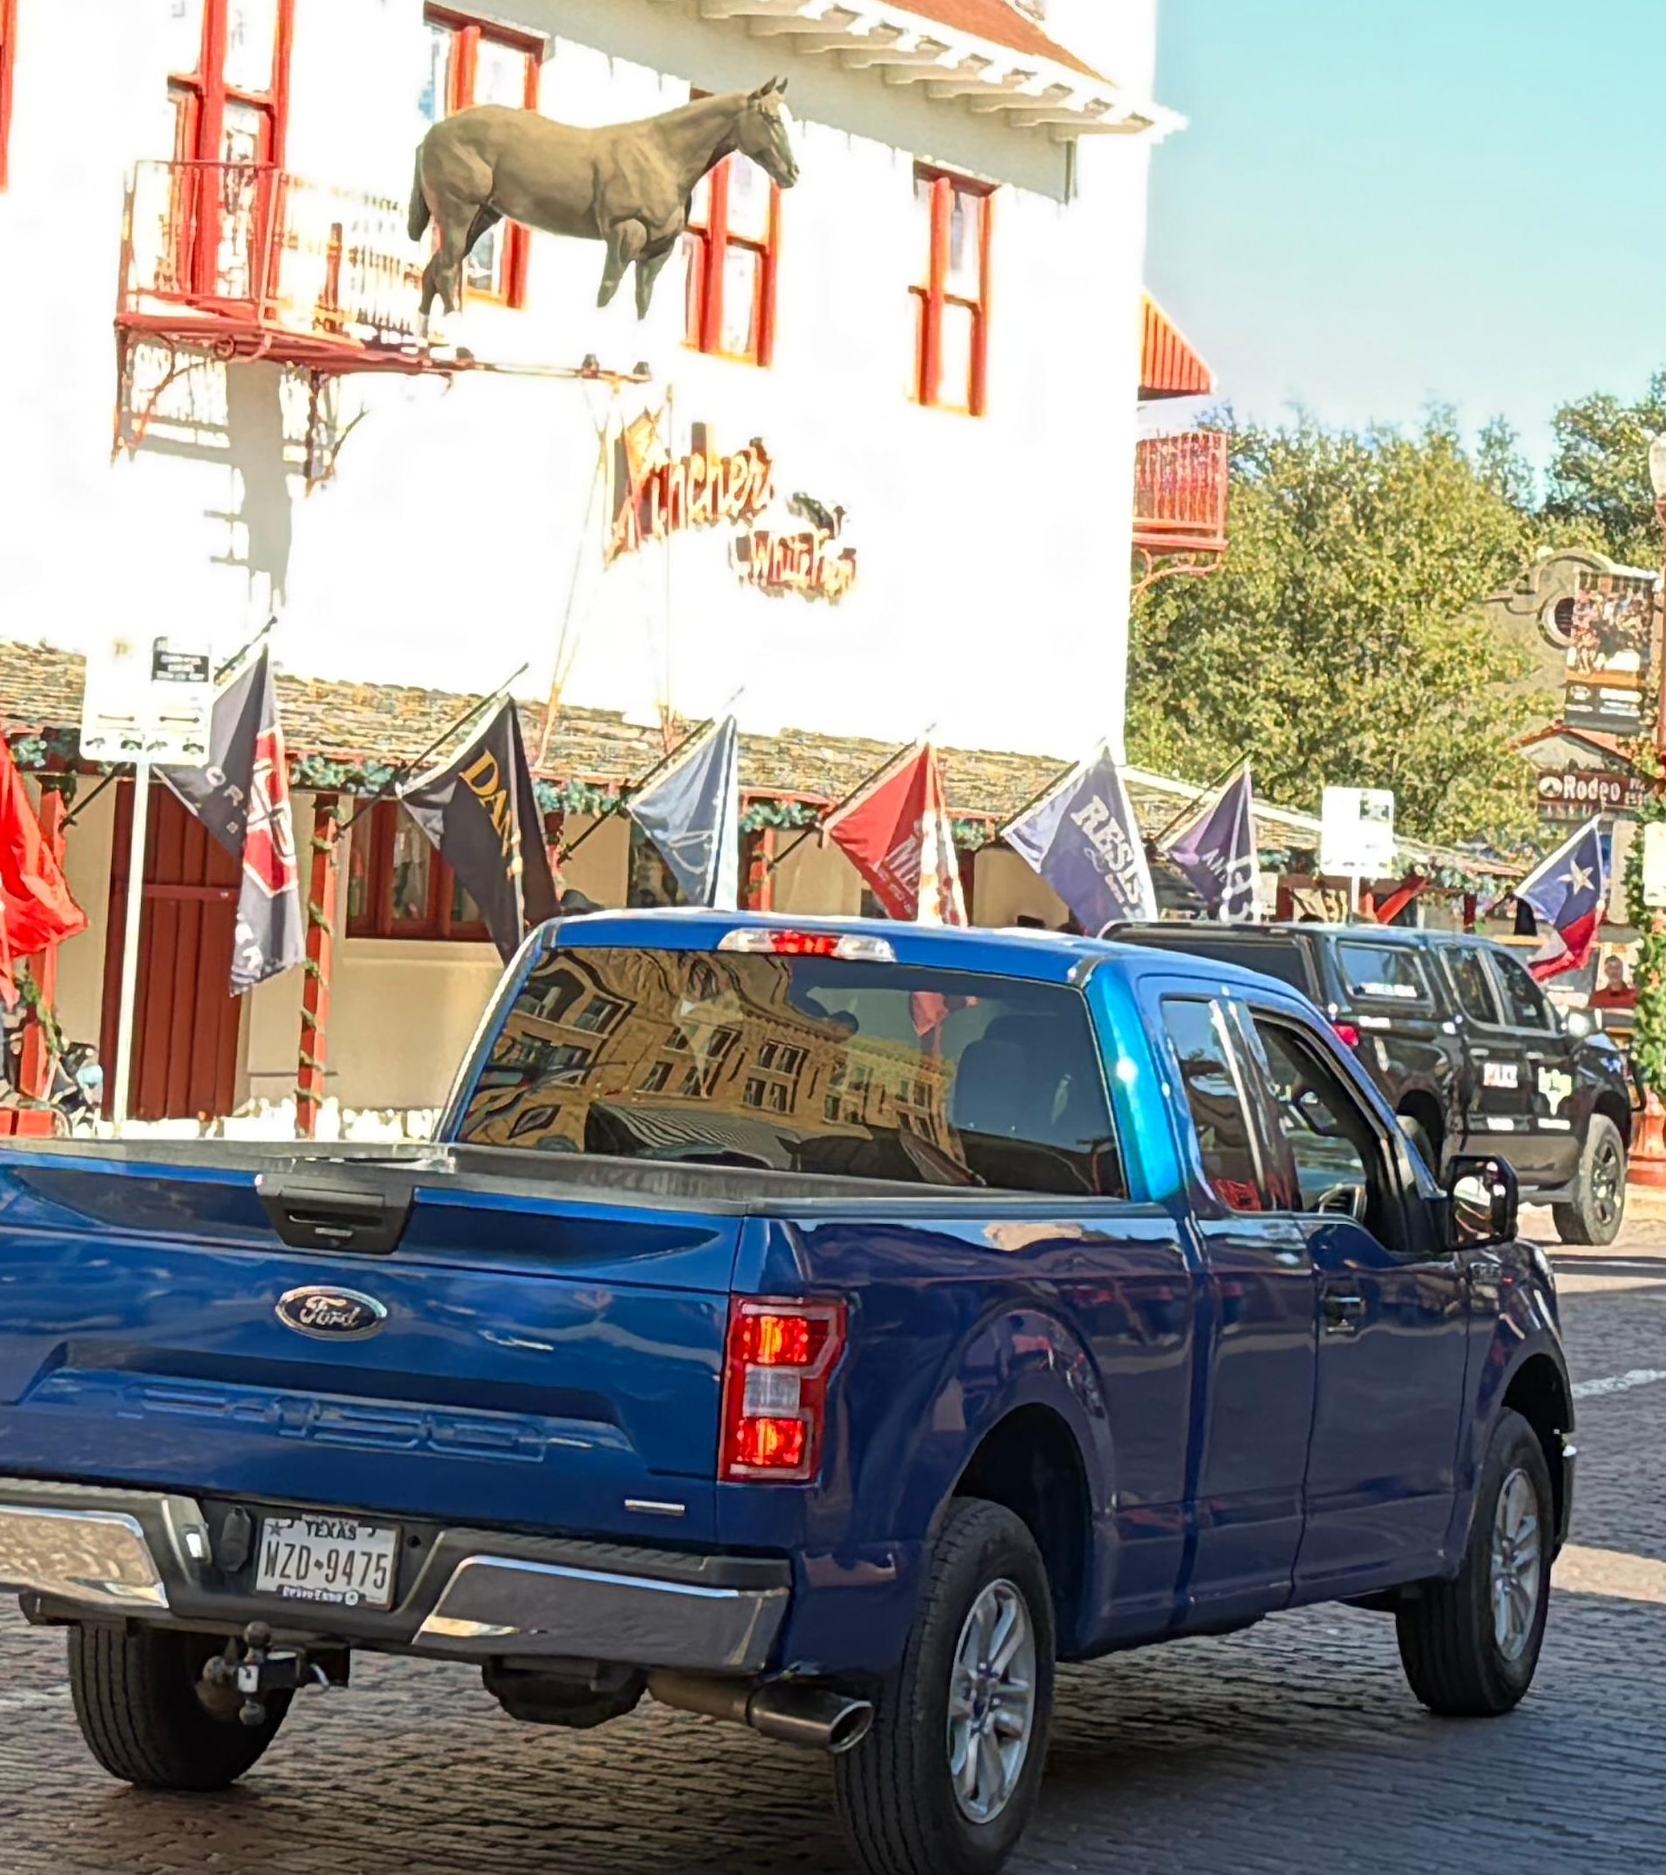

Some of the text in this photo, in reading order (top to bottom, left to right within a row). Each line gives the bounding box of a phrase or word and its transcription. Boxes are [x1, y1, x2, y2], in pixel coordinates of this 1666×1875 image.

[1563, 774, 1621, 802] Rodeo
[299, 1295, 361, 1327] Ford
[304, 1519, 357, 1541] TEXAS
